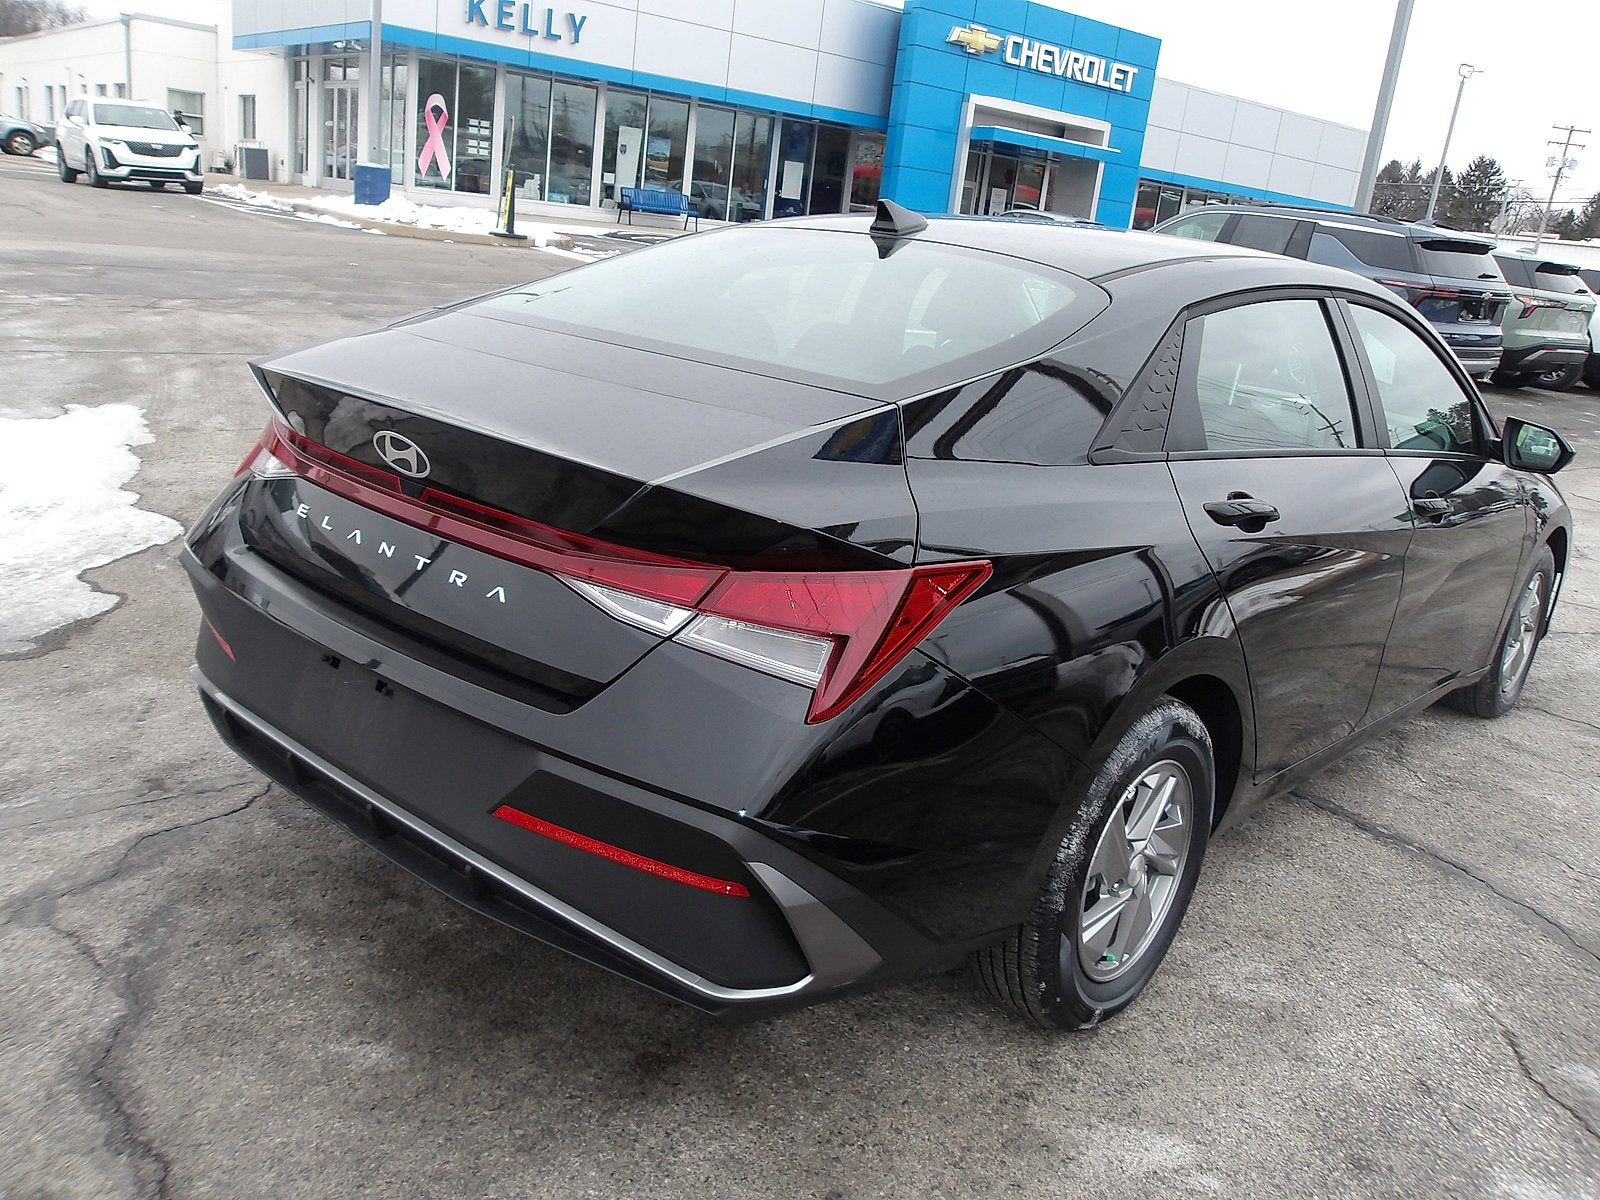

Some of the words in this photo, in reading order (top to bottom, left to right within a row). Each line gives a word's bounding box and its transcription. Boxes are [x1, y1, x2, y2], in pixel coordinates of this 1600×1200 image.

[466, 0, 587, 44] KELLY
[1004, 34, 1139, 93] CHEVROLET
[296, 502, 506, 604] ELANTRA
